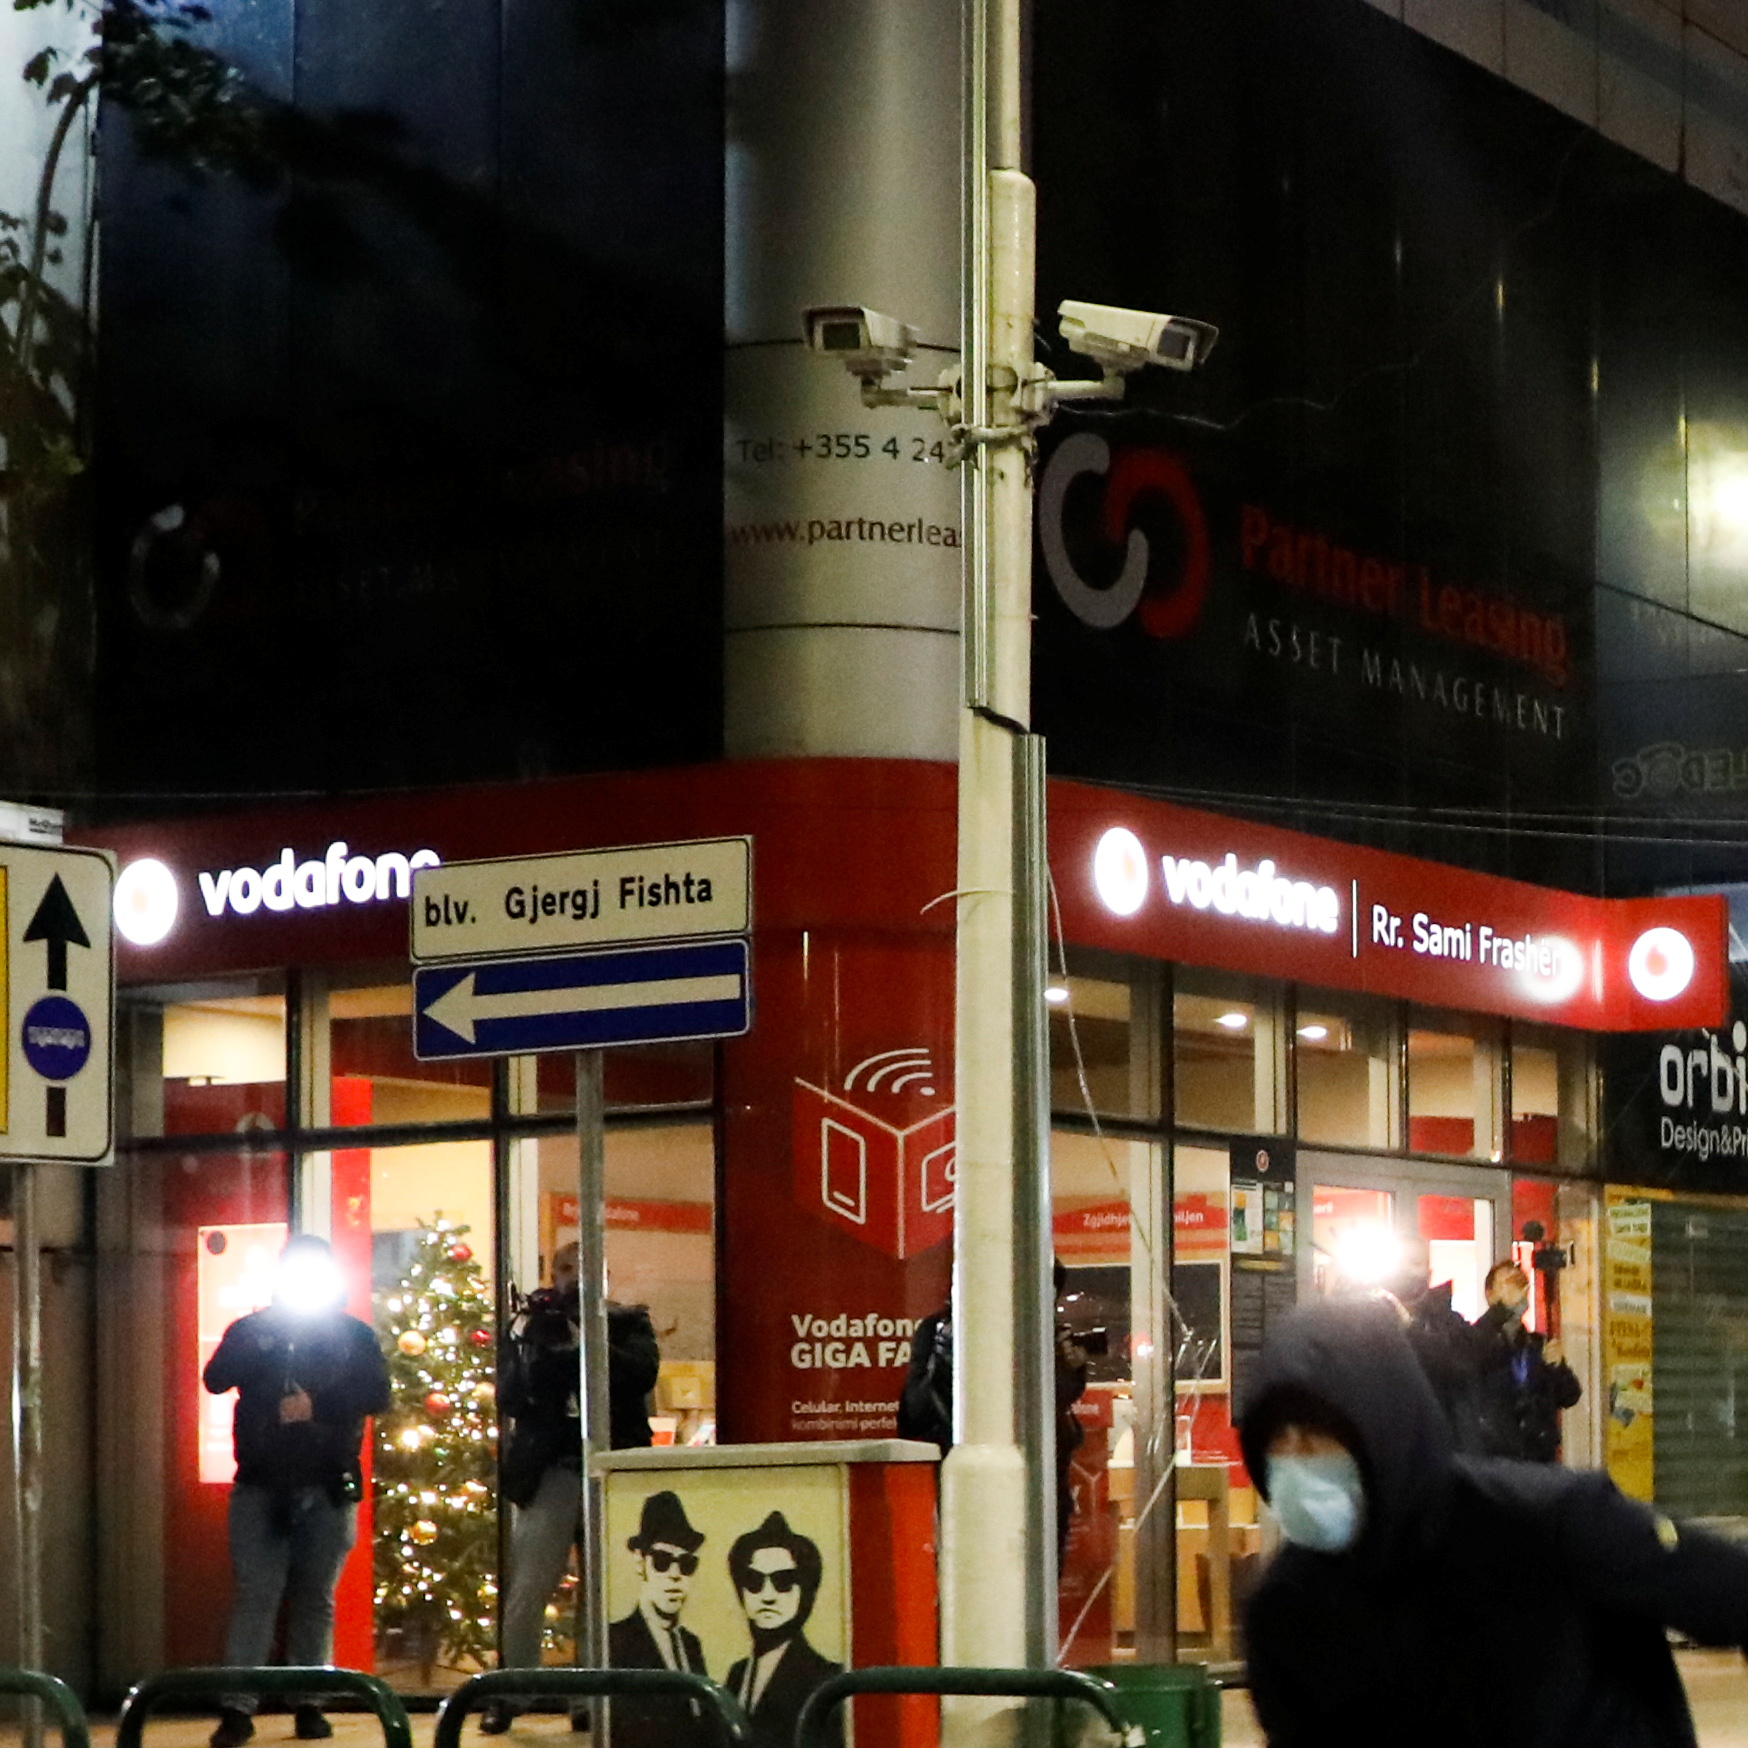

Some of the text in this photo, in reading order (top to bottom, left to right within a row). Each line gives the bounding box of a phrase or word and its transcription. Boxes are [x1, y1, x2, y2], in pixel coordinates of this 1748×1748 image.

[792, 433, 871, 460] +355
[881, 436, 900, 460] 4
[728, 517, 963, 550] www.partnerlea
[1239, 501, 1406, 618] Partner
[1243, 612, 1566, 741] ASSET MANAGEMENT
[424, 873, 714, 929] blv. Gjergj Fishta
[1161, 852, 1340, 934] vodafone
[1371, 904, 1405, 949] Rr.
[1411, 911, 1473, 959] Sami
[790, 1341, 872, 1370] GIGA
